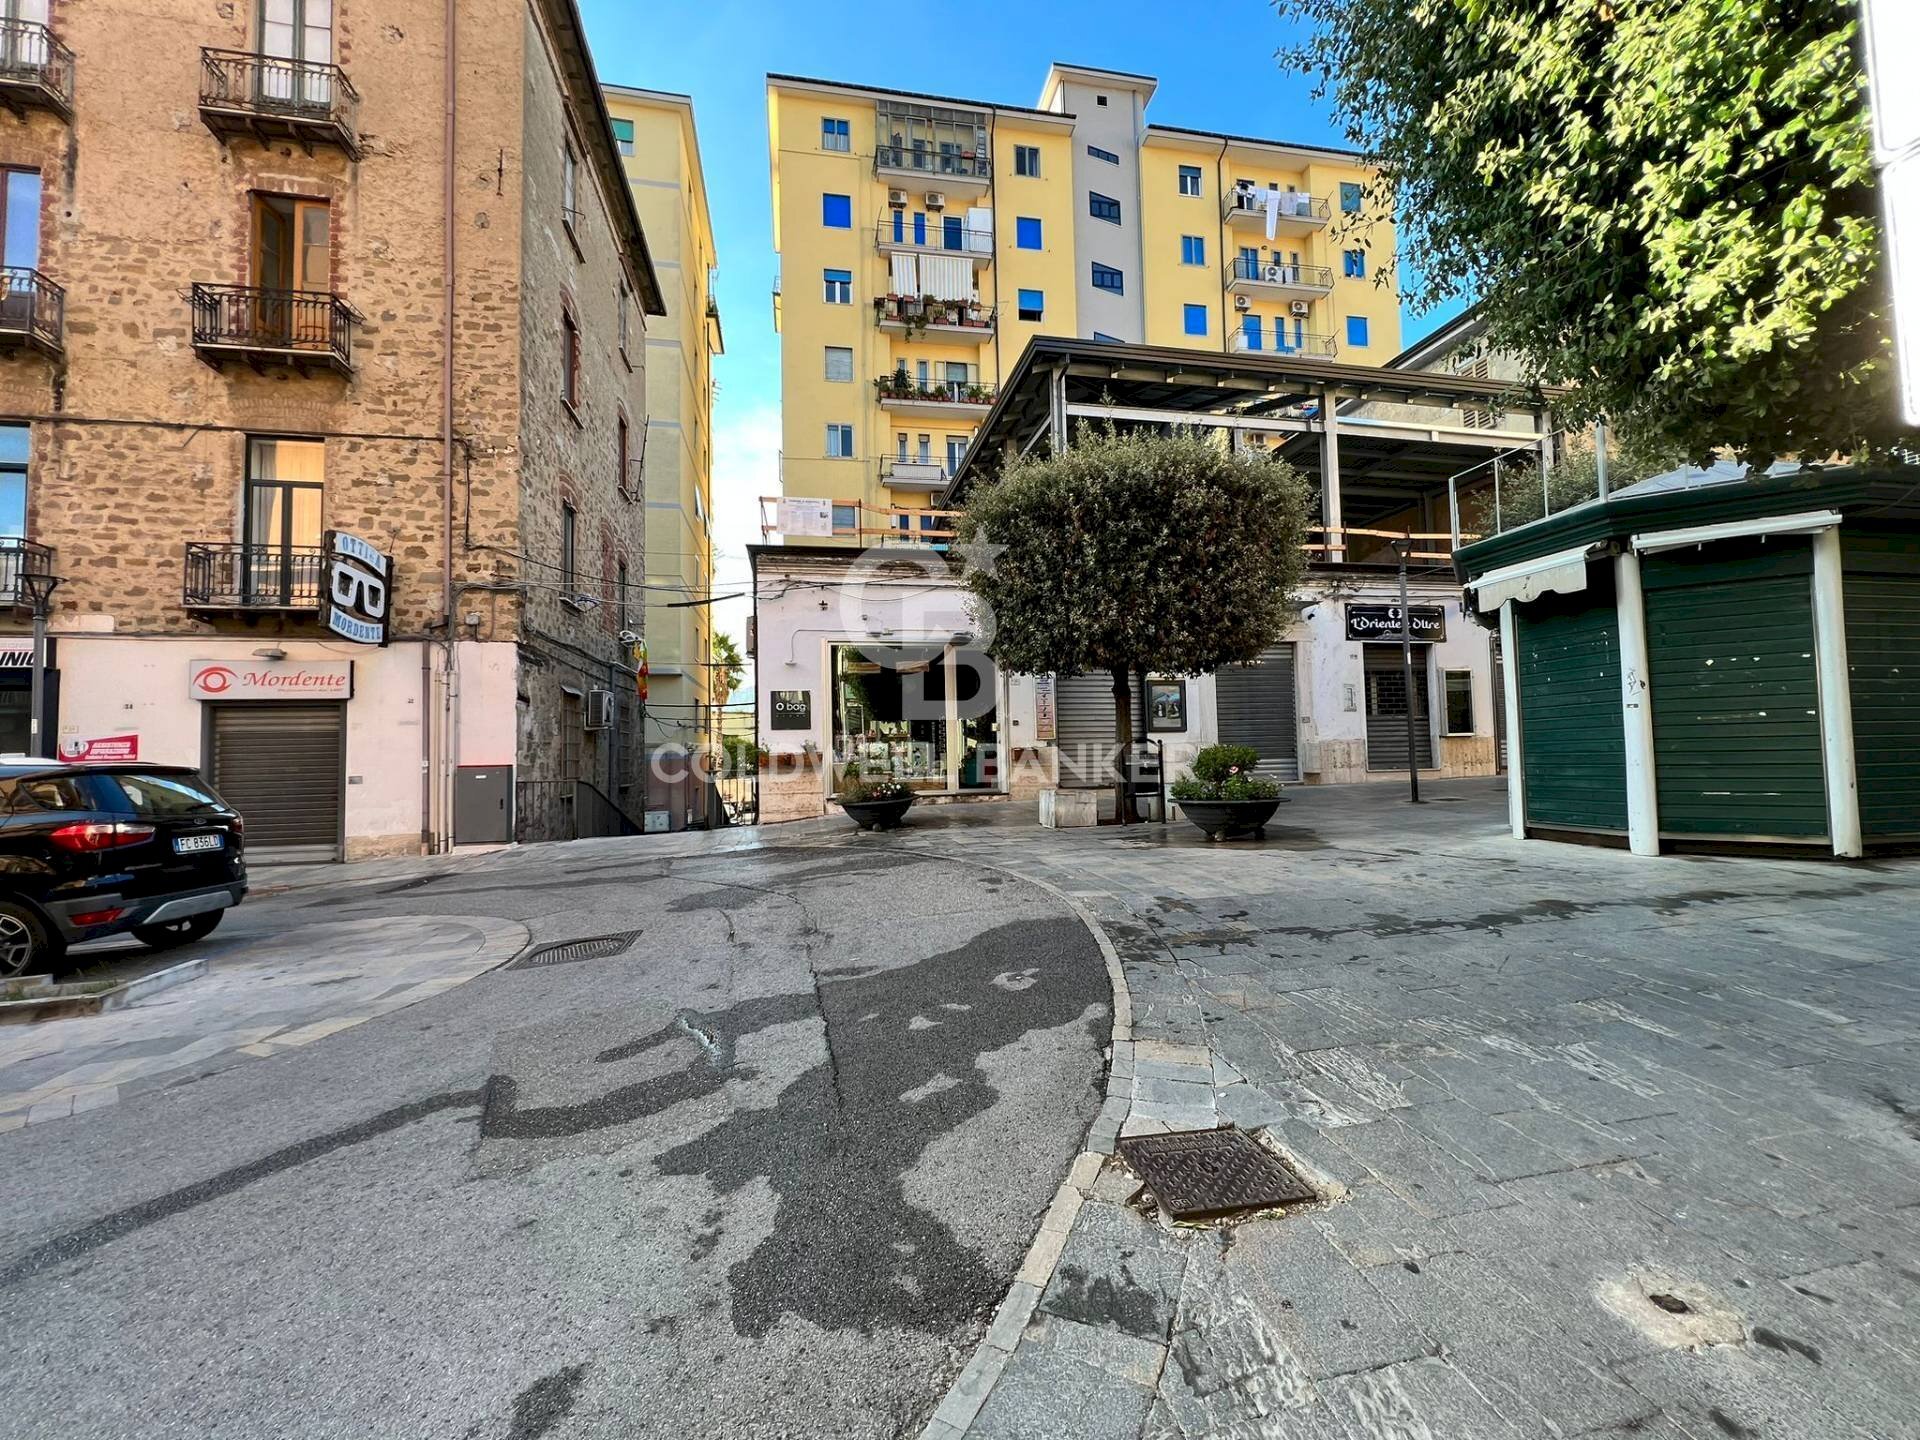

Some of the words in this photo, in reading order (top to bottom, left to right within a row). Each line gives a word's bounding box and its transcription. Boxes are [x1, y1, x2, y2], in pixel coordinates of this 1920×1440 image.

[332, 611, 381, 640] MORDENTE
[242, 669, 346, 687] Mordente
[786, 702, 806, 713] bag
